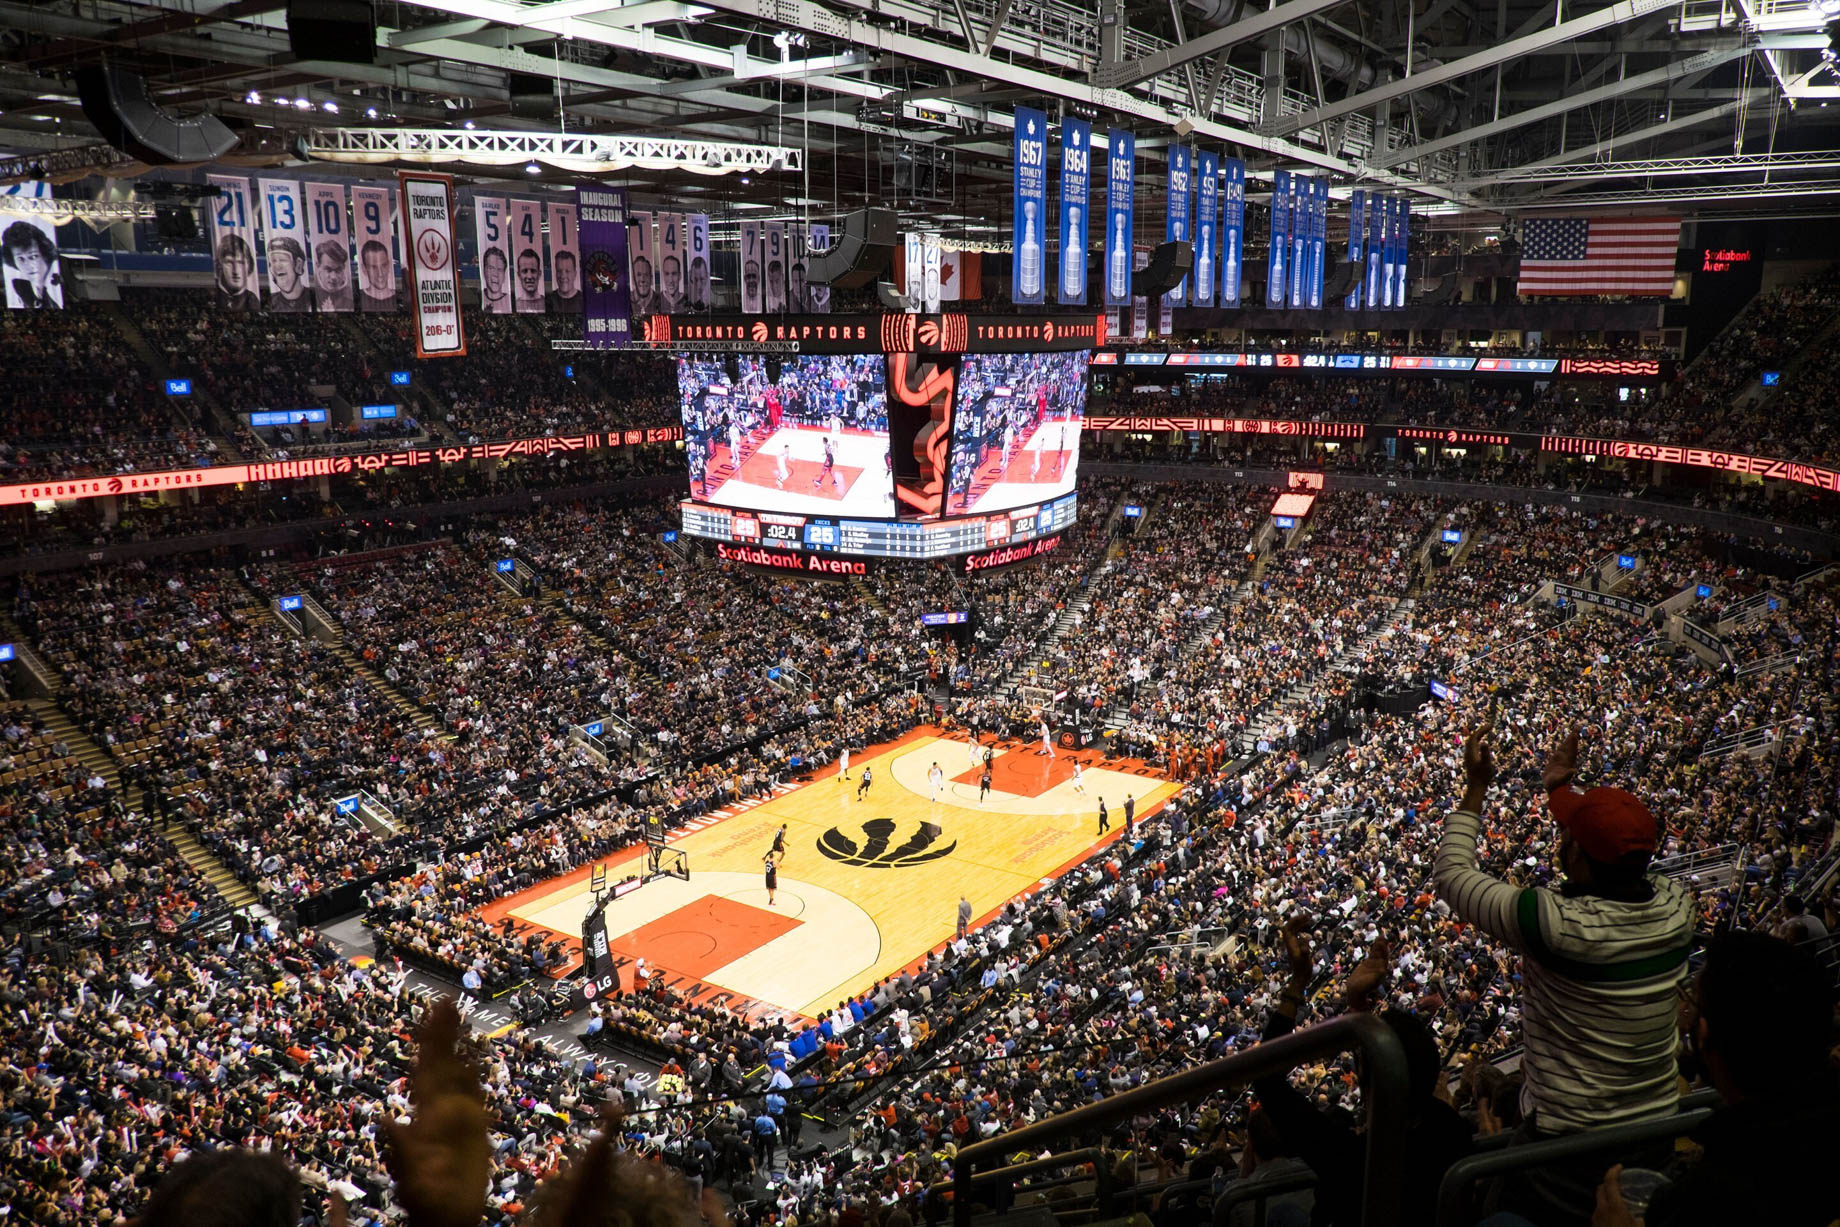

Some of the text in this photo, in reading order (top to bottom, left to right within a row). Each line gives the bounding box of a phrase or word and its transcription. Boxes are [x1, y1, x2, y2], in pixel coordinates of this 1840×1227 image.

[1020, 139, 1042, 166] 1967
[1064, 147, 1087, 174] 1964
[1020, 166, 1042, 178] STANLEY
[1112, 157, 1130, 181] 1963
[1025, 179, 1036, 188] CUP
[411, 194, 445, 207] TORONTO
[580, 191, 622, 207] INAUGURAL
[217, 190, 245, 227] 21
[267, 193, 296, 230] 13
[313, 199, 341, 235] 10
[413, 208, 446, 220] RAPTORS
[581, 207, 623, 223] SEASON
[364, 201, 381, 235] 9
[485, 210, 499, 241] 5
[521, 213, 534, 244] 4
[560, 215, 567, 246] 1
[665, 223, 676, 251] 4
[693, 225, 704, 252] 6
[746, 230, 755, 256] 7
[770, 231, 780, 257] 9
[1704, 249, 1751, 261] Scotiabank
[1703, 261, 1730, 272] Arena
[678, 325, 866, 340] TORONTO RAPTORS
[978, 324, 1094, 340] TORONTO RAPTORS
[170, 382, 187, 393] Bell
[1397, 429, 1510, 445] TORONTO RAPTORS
[20, 473, 203, 499] TORONTO RAPTORS
[736, 518, 755, 537] 25
[1279, 518, 1291, 526] Bell
[768, 524, 796, 540] :02.4
[810, 526, 834, 543] 25
[1446, 531, 1458, 540] Bell
[717, 543, 866, 575] Scotiabank Arena
[965, 535, 1061, 571] Scotiabank Arena
[499, 561, 511, 570] Bell
[284, 598, 298, 609] Bell
[1555, 586, 1568, 595] IBM
[1571, 590, 1584, 599] IBM
[1587, 593, 1600, 603] IBM
[1604, 597, 1617, 607] IBM
[1620, 601, 1630, 611] IBM
[589, 724, 600, 734] Bell
[596, 975, 613, 992] LG
[408, 982, 451, 1003] THE
[532, 1034, 628, 1074] ALWAYS
